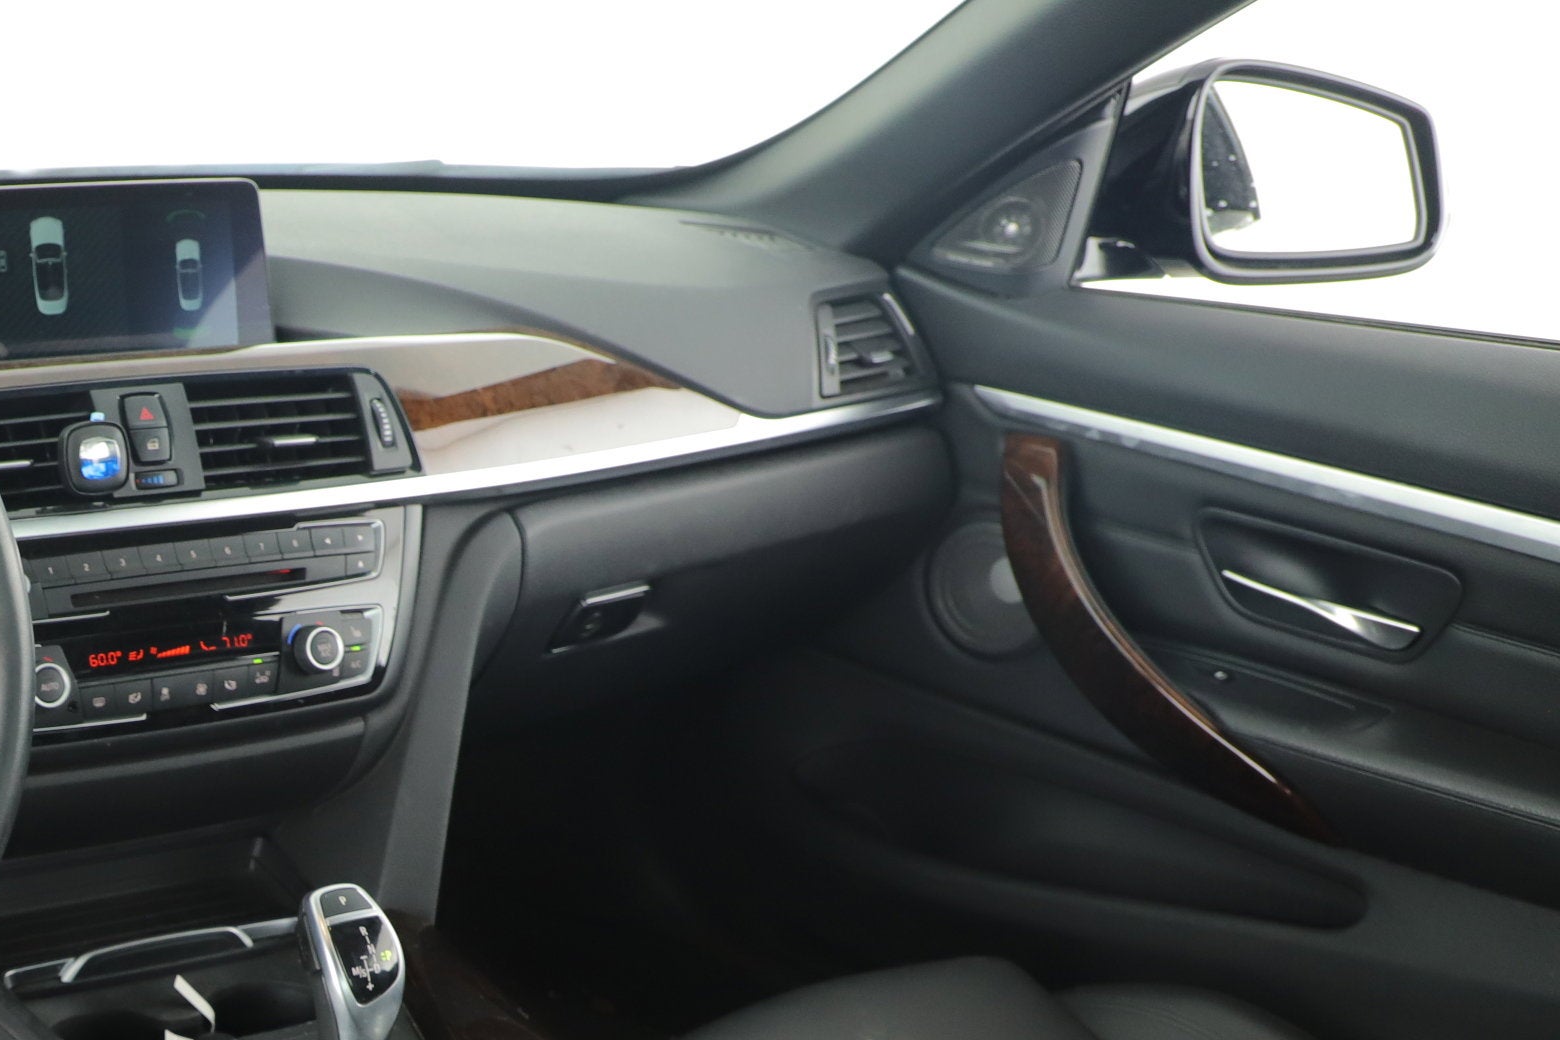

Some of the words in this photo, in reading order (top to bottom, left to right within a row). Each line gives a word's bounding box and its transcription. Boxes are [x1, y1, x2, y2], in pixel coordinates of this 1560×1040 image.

[155, 554, 163, 563] 4
[190, 550, 197, 559] 5
[119, 558, 127, 567] 3
[47, 566, 55, 576] 1
[83, 563, 90, 572] 2
[338, 895, 347, 906] P
[358, 925, 369, 937] R
[373, 963, 381, 975] D
